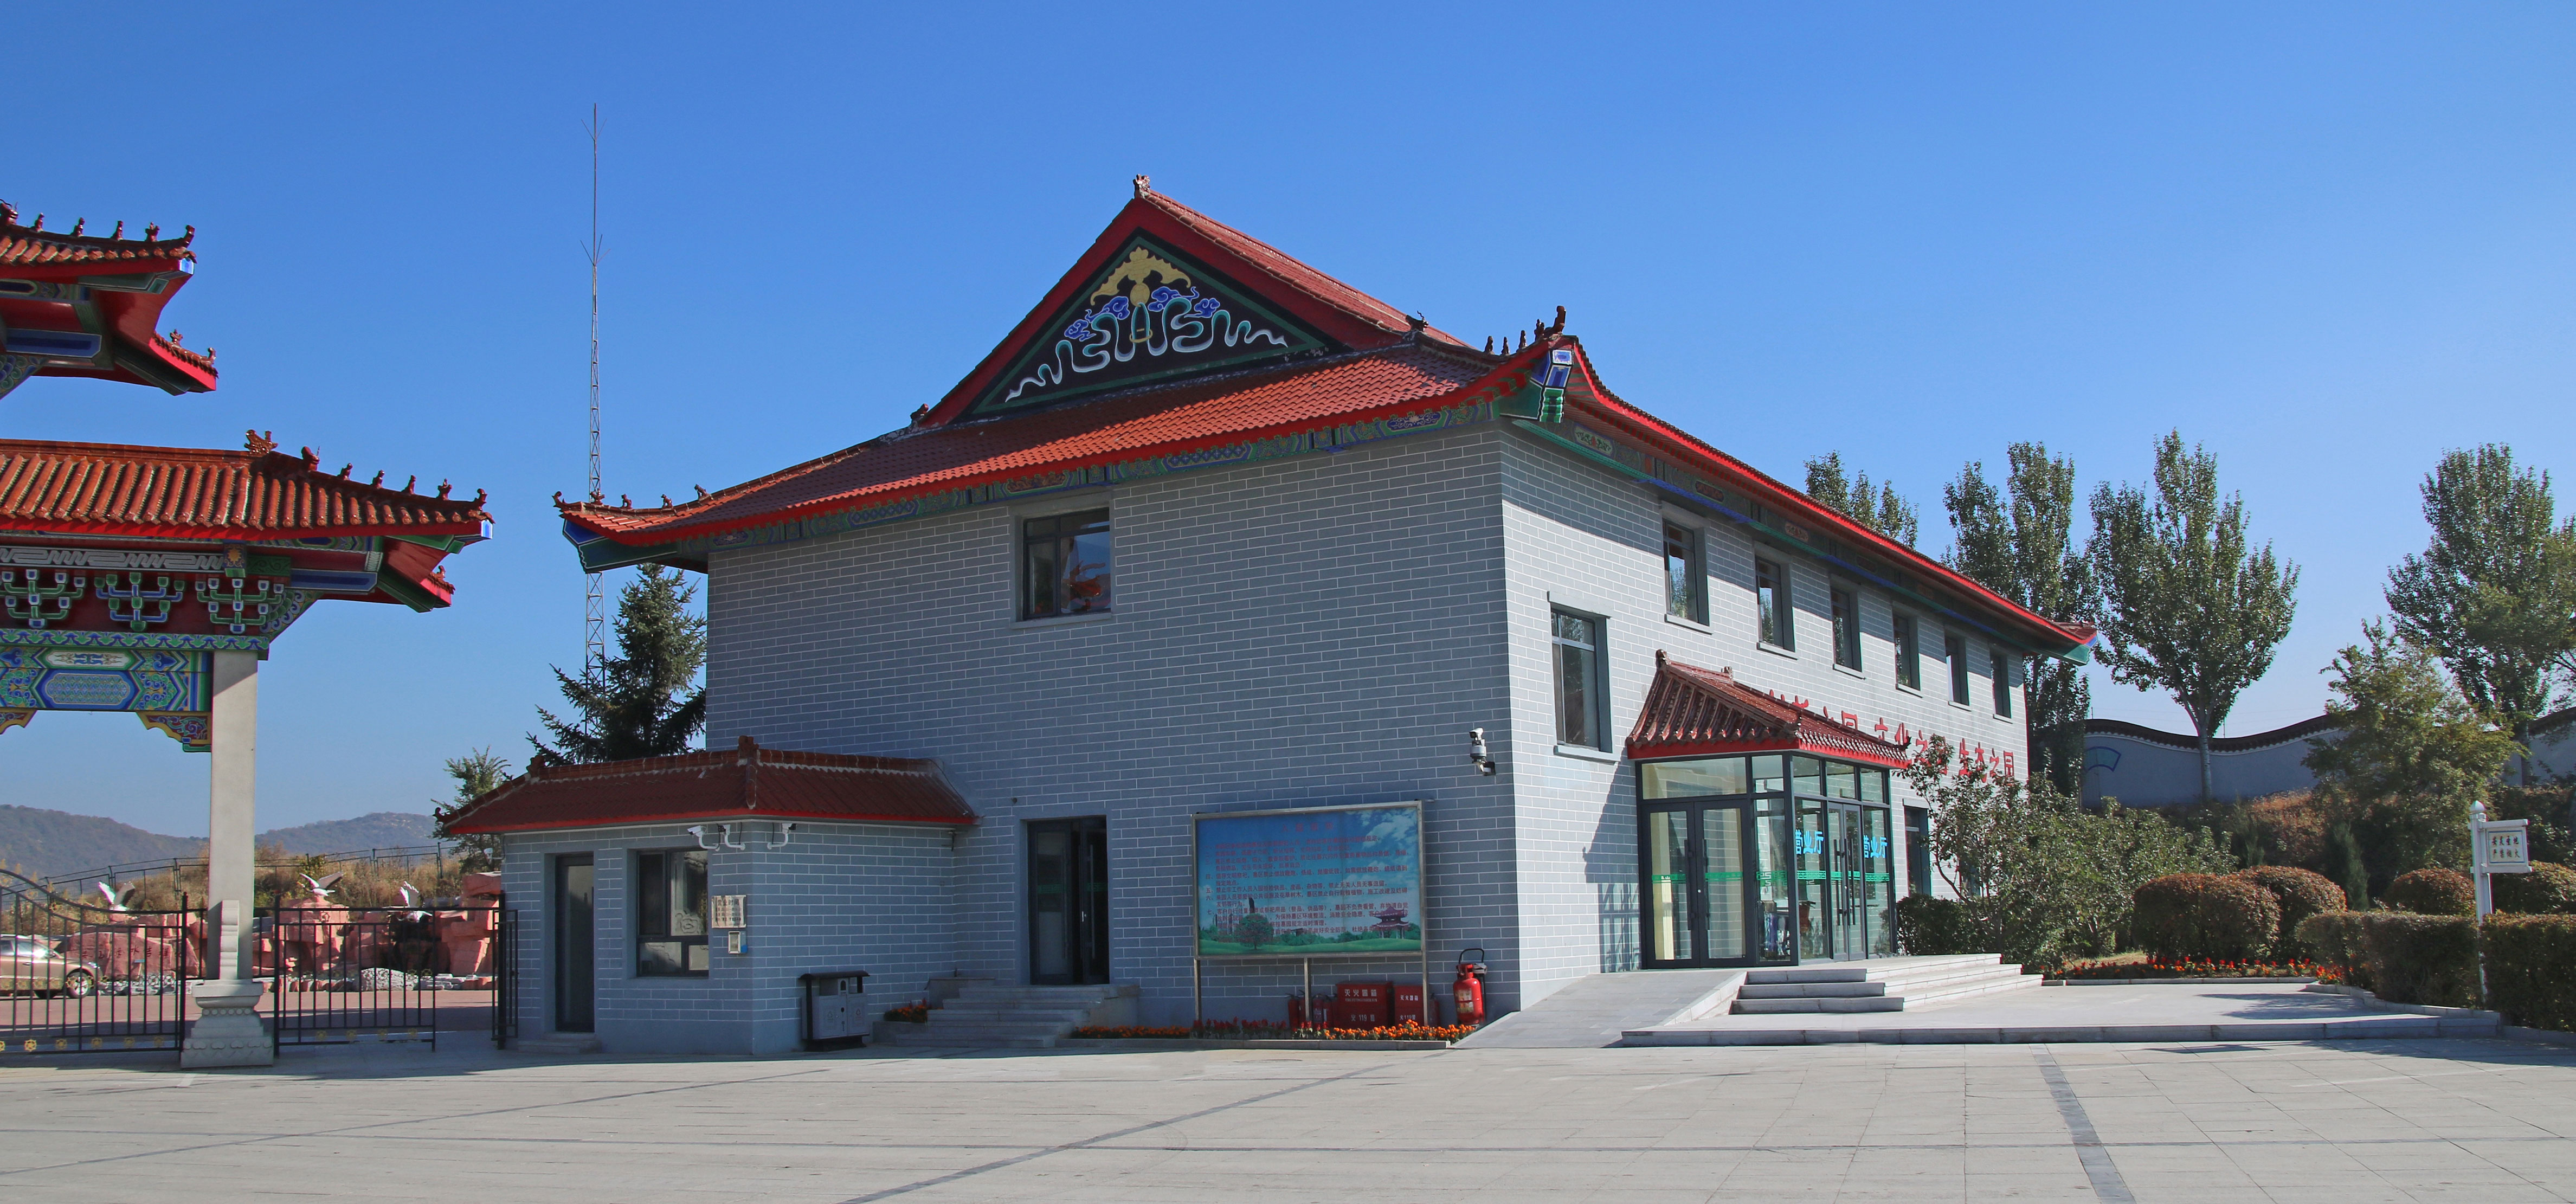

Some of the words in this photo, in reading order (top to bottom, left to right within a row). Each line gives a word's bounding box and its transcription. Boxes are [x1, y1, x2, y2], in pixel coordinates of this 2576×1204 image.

[1795, 829, 1824, 855] 营业厅
[1863, 834, 1888, 859] 营业厅
